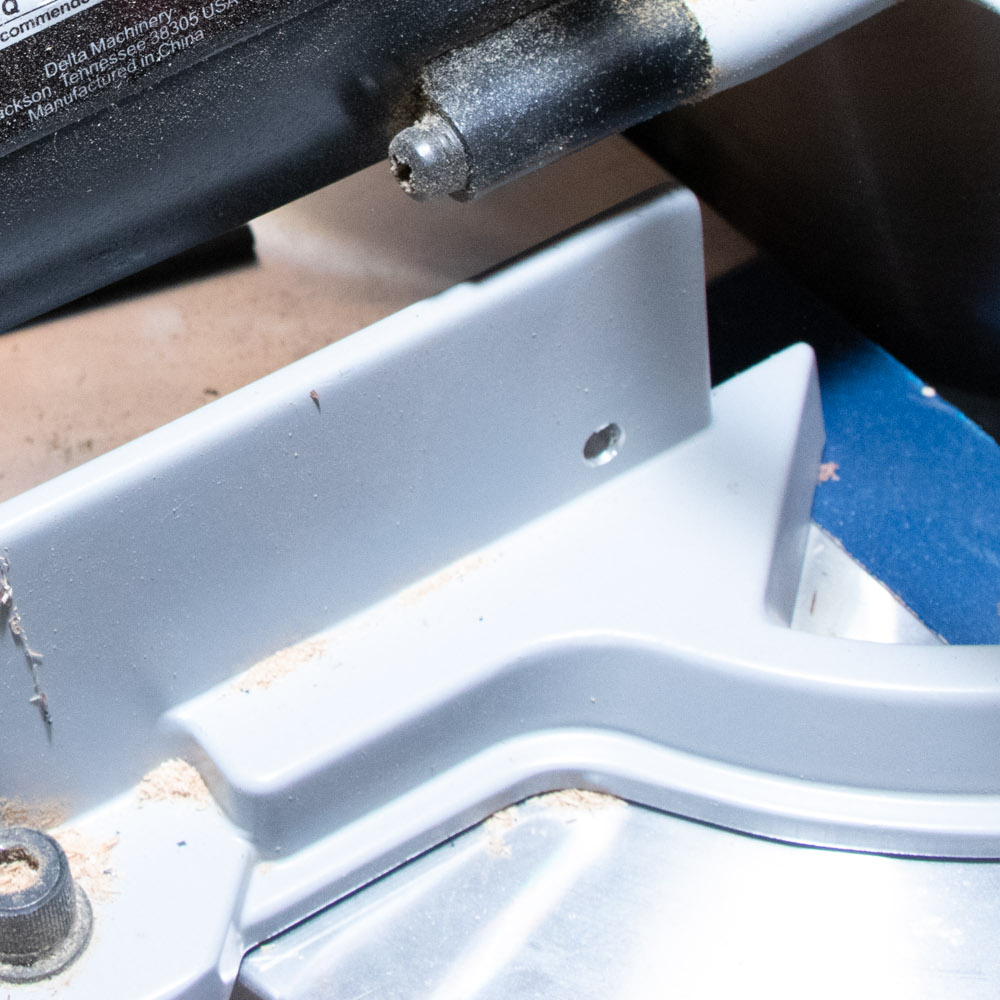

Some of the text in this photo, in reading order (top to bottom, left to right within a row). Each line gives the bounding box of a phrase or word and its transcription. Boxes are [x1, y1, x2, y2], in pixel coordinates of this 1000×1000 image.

[26, 26, 205, 123] Manufactured in China
[42, 6, 176, 79] Delta Machinery
[59, 36, 148, 87] Tennessee
[148, 10, 201, 44] 38305
